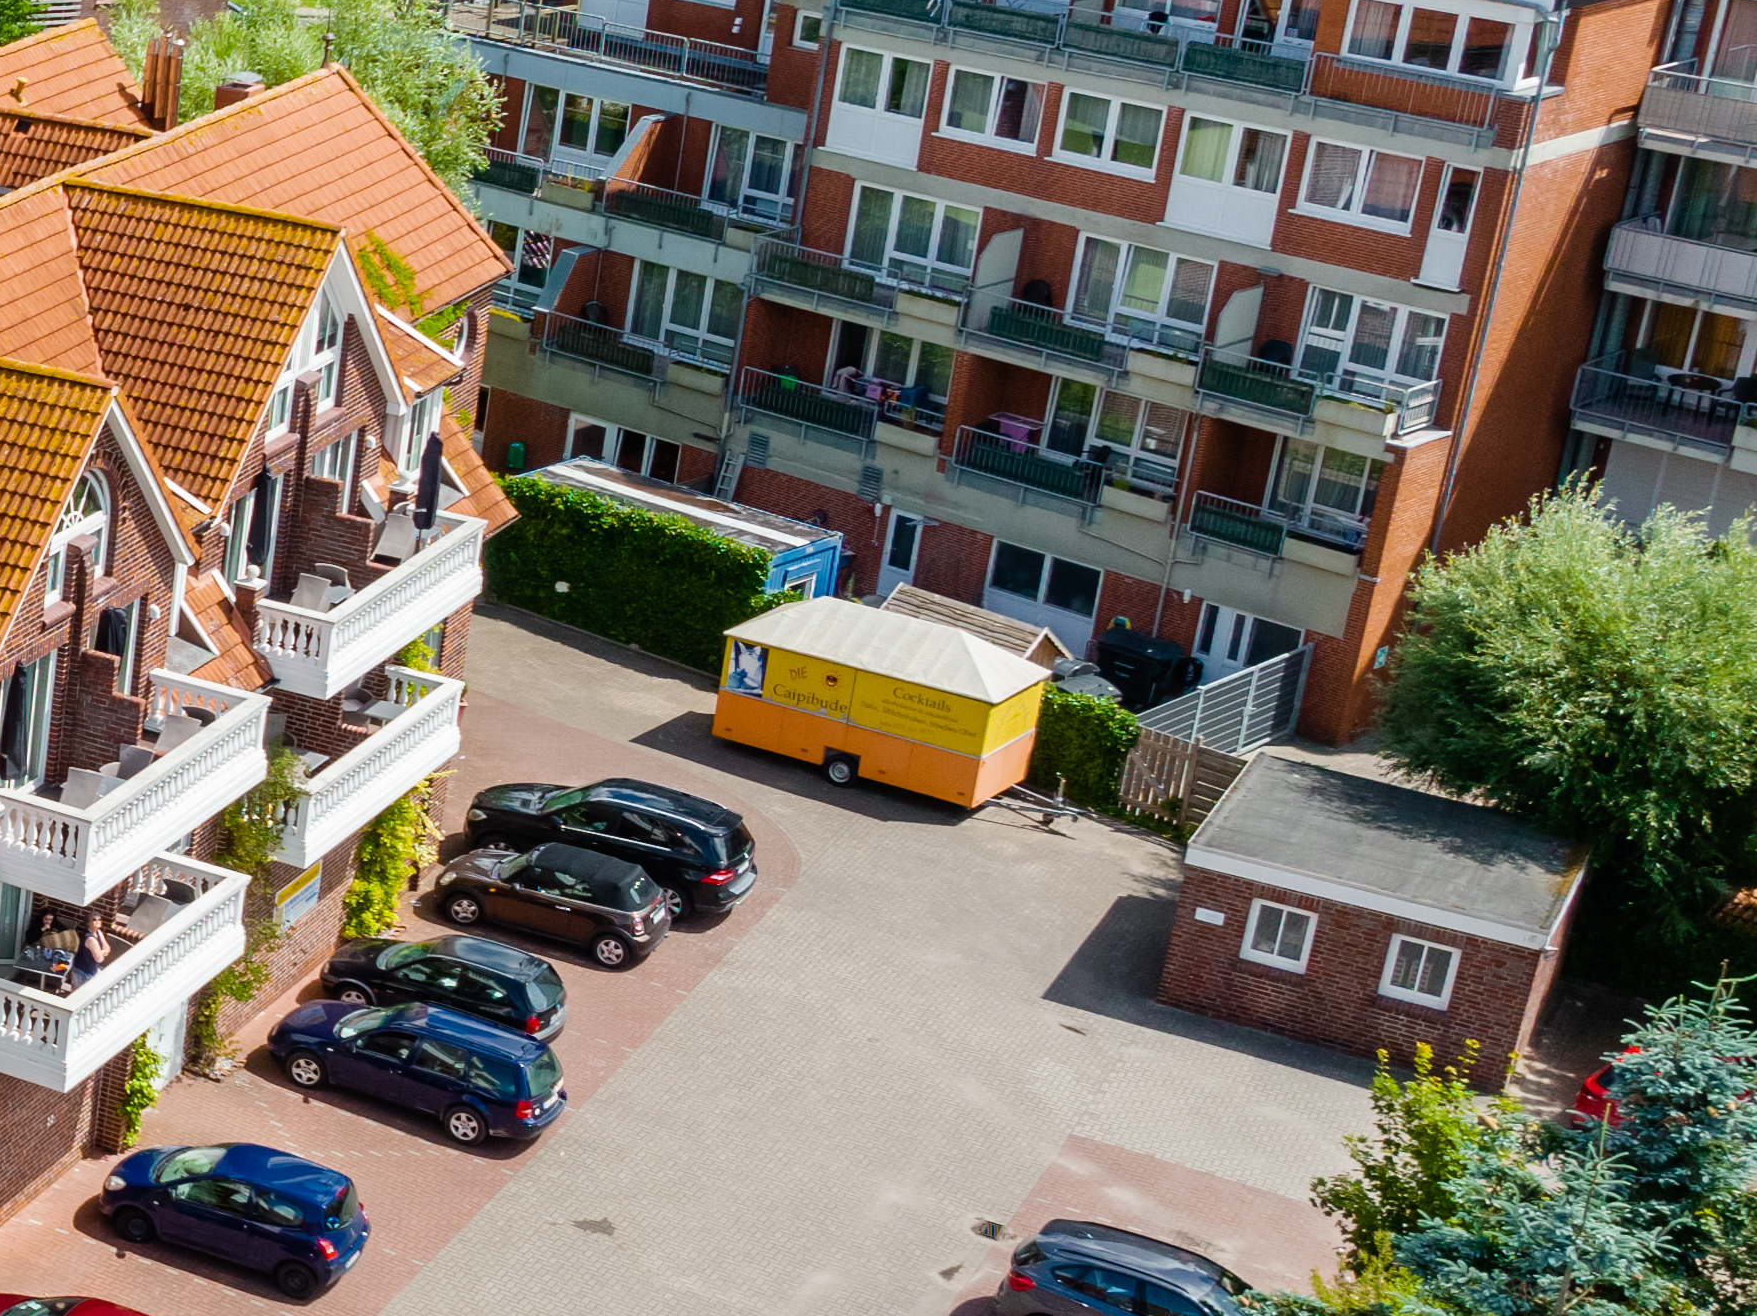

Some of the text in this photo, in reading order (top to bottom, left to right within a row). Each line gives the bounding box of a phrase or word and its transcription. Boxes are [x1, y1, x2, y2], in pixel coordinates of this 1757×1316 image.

[789, 666, 809, 681] DIE
[773, 683, 849, 714] Caipibude
[893, 687, 952, 713] Cocktails
